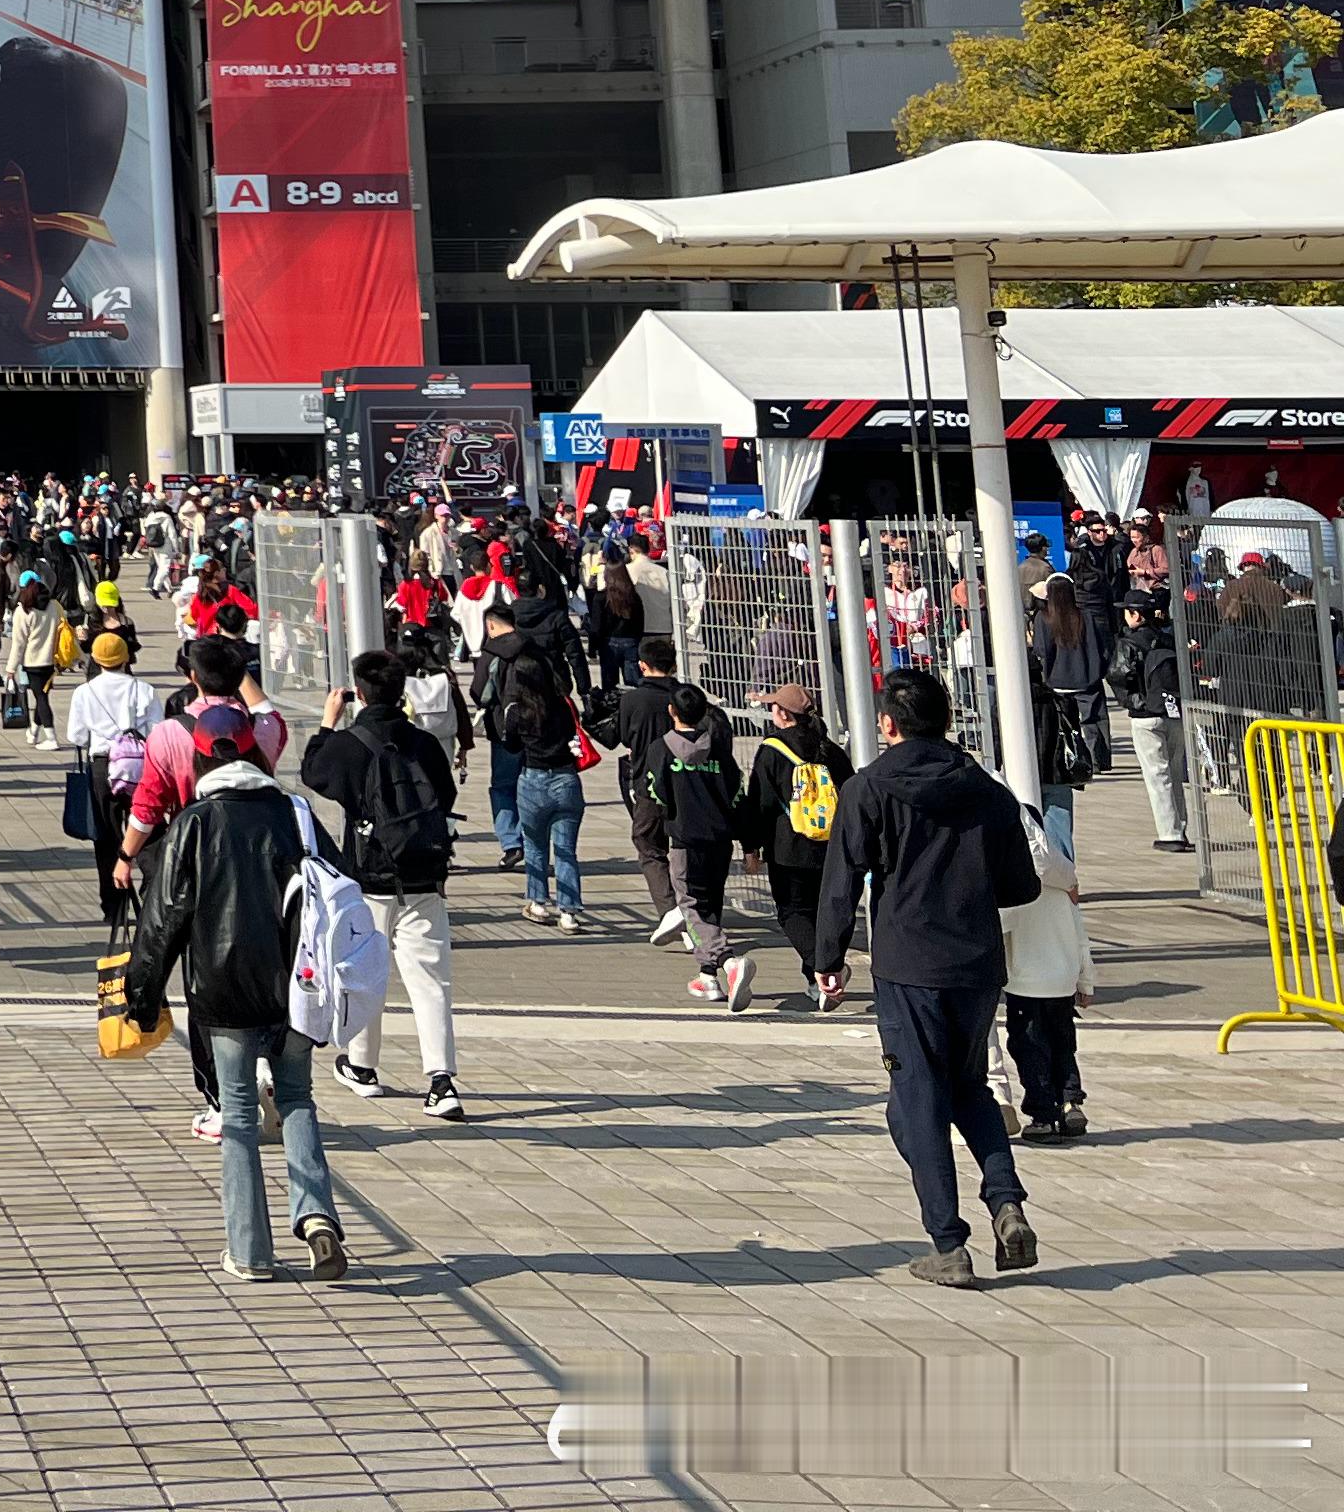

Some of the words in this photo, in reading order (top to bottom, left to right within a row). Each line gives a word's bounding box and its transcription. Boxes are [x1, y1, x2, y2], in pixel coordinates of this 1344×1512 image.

[220, 65, 294, 76] FORMULA
[229, 178, 262, 208] A
[286, 181, 342, 205] 8-9
[352, 190, 400, 204] abcd
[932, 411, 971, 427] Sto
[1281, 409, 1344, 427] Store
[565, 420, 605, 437] AM
[572, 438, 606, 455] EX
